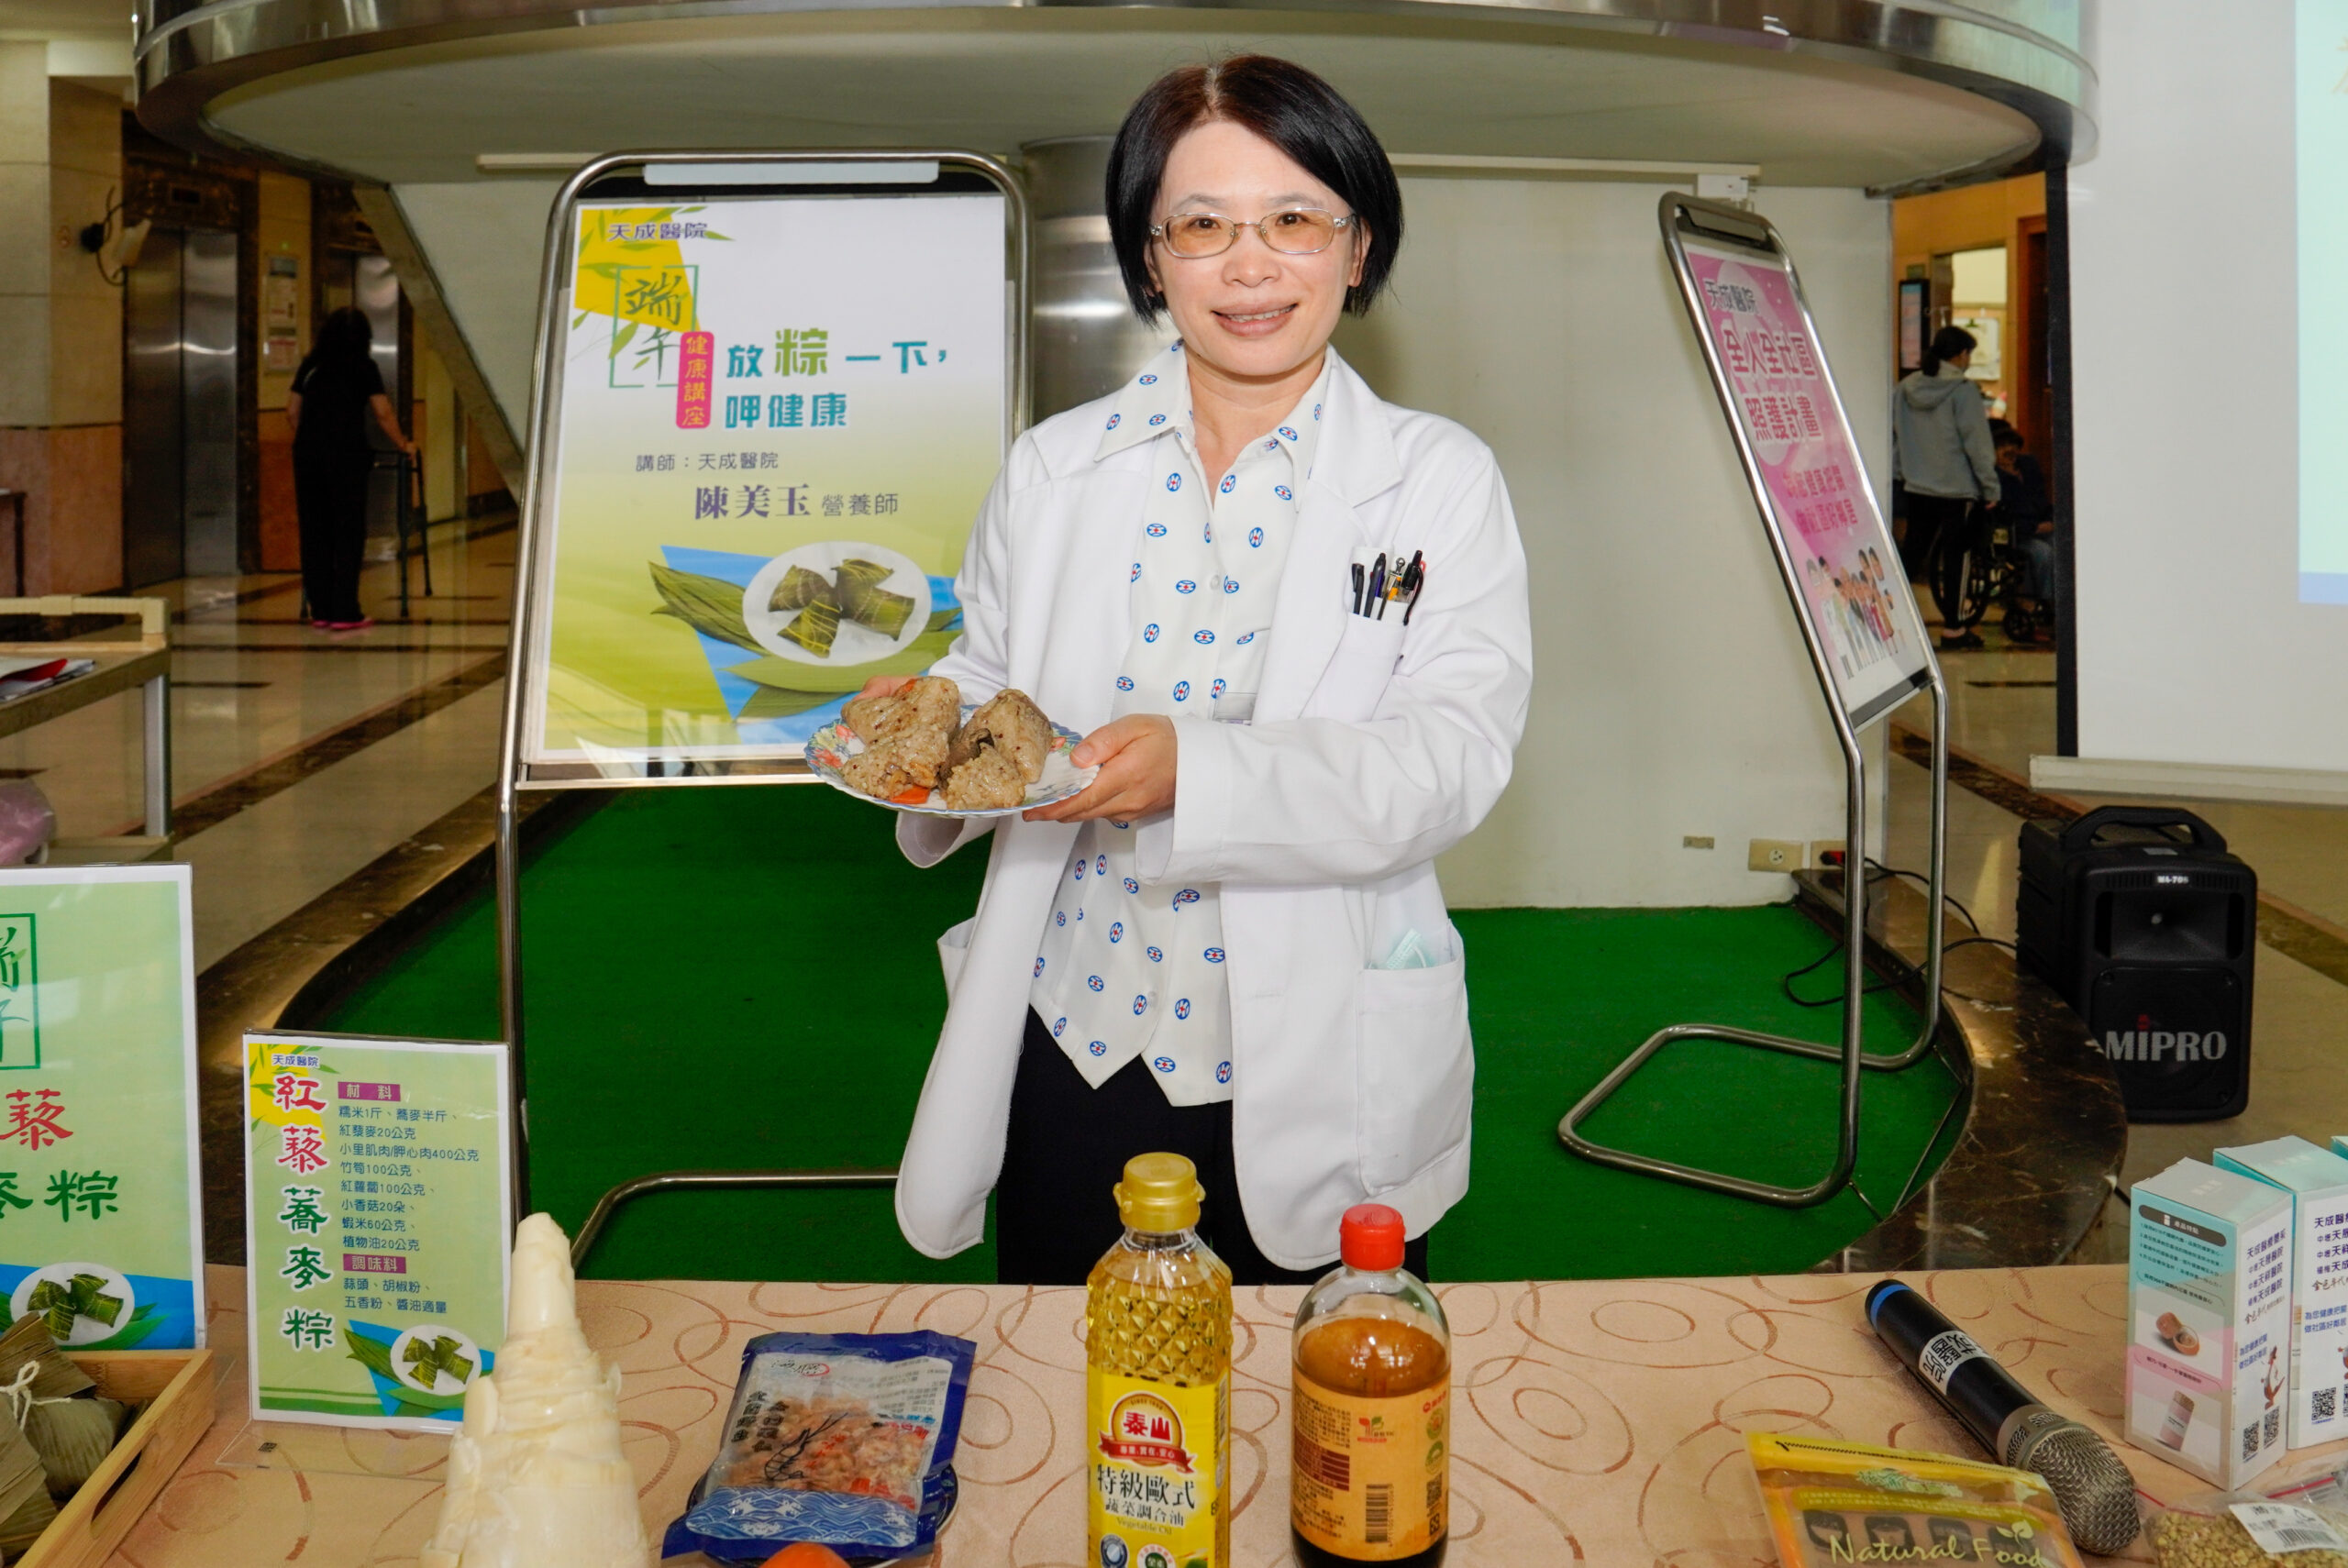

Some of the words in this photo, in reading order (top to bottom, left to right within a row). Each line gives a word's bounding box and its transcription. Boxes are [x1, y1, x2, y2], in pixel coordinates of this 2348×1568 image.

[607, 222, 708, 241] 天成醫院
[1704, 281, 1757, 313] 天成醫院
[625, 272, 683, 381] 端午
[1724, 329, 1816, 376] 全人全社區
[682, 334, 708, 426] 健康講座
[725, 392, 847, 428] 呷健康
[1744, 395, 1822, 440] 照護計畫
[694, 484, 811, 519] 陳美玉
[821, 492, 899, 516] 營養師
[2106, 1015, 2227, 1061] MIPRO
[273, 1055, 319, 1066] 天成醫院
[347, 1084, 392, 1099] 材料
[275, 1075, 334, 1350] 紅藜蕎麥粽
[343, 1235, 420, 1251] 植物油20公克
[352, 1256, 397, 1272] 調味料
[1924, 1333, 1986, 1383] 成醫院
[1123, 1411, 1170, 1441] 泰山
[1097, 1463, 1195, 1509] 特級歐式
[1105, 1497, 1184, 1527] 蔬菜調合油
[1116, 1517, 1157, 1532] Vegetable
[1158, 1526, 1172, 1534] Oil
[1830, 1532, 1966, 1564] Natural
[1973, 1538, 2043, 1568] Food
